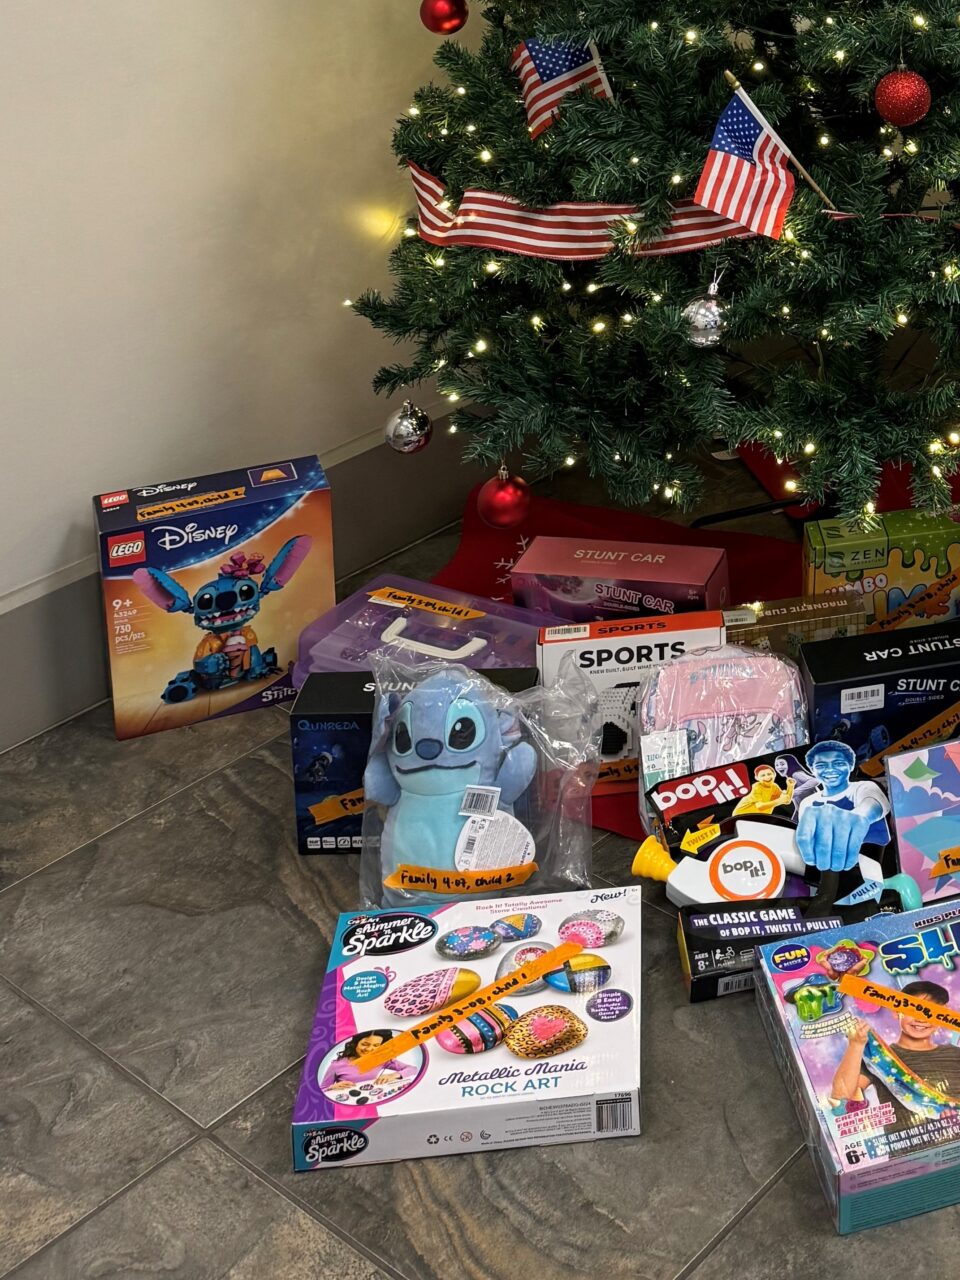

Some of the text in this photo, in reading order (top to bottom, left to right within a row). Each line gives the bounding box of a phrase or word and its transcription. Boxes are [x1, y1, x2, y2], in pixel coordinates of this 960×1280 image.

[111, 541, 144, 558] LEGO
[574, 549, 666, 564] STUNT CAR
[851, 547, 885, 561] ZEN
[112, 598, 133, 610] 9+
[595, 583, 642, 605] STUNT
[642, 594, 675, 615] CAR
[114, 624, 132, 634] 730
[597, 621, 667, 635] SPORTS
[579, 641, 686, 669] SPORTS
[863, 646, 903, 662] CAR
[896, 678, 947, 691] STUNT
[650, 774, 717, 811] bop
[686, 831, 709, 847] TWIST
[722, 860, 767, 878] bop it!
[401, 870, 438, 890] Family
[505, 872, 515, 883] 2
[590, 889, 628, 904] New!
[851, 886, 871, 900] PULL
[693, 908, 797, 927] THE CLASSIC GAME
[914, 916, 941, 928] KIDS
[355, 916, 414, 936] shimmer
[719, 919, 842, 937] OF BOP IT, TWIST IT, PULL IT!
[341, 923, 434, 956] Sparkle
[773, 948, 808, 963] FUN
[863, 985, 902, 1008] Family
[438, 1059, 589, 1086] Metallic Mania
[460, 1075, 563, 1098] ROCK ART
[305, 1134, 366, 1163] Sparkle
[844, 1140, 863, 1151] AGE
[845, 1150, 868, 1165] 6+
